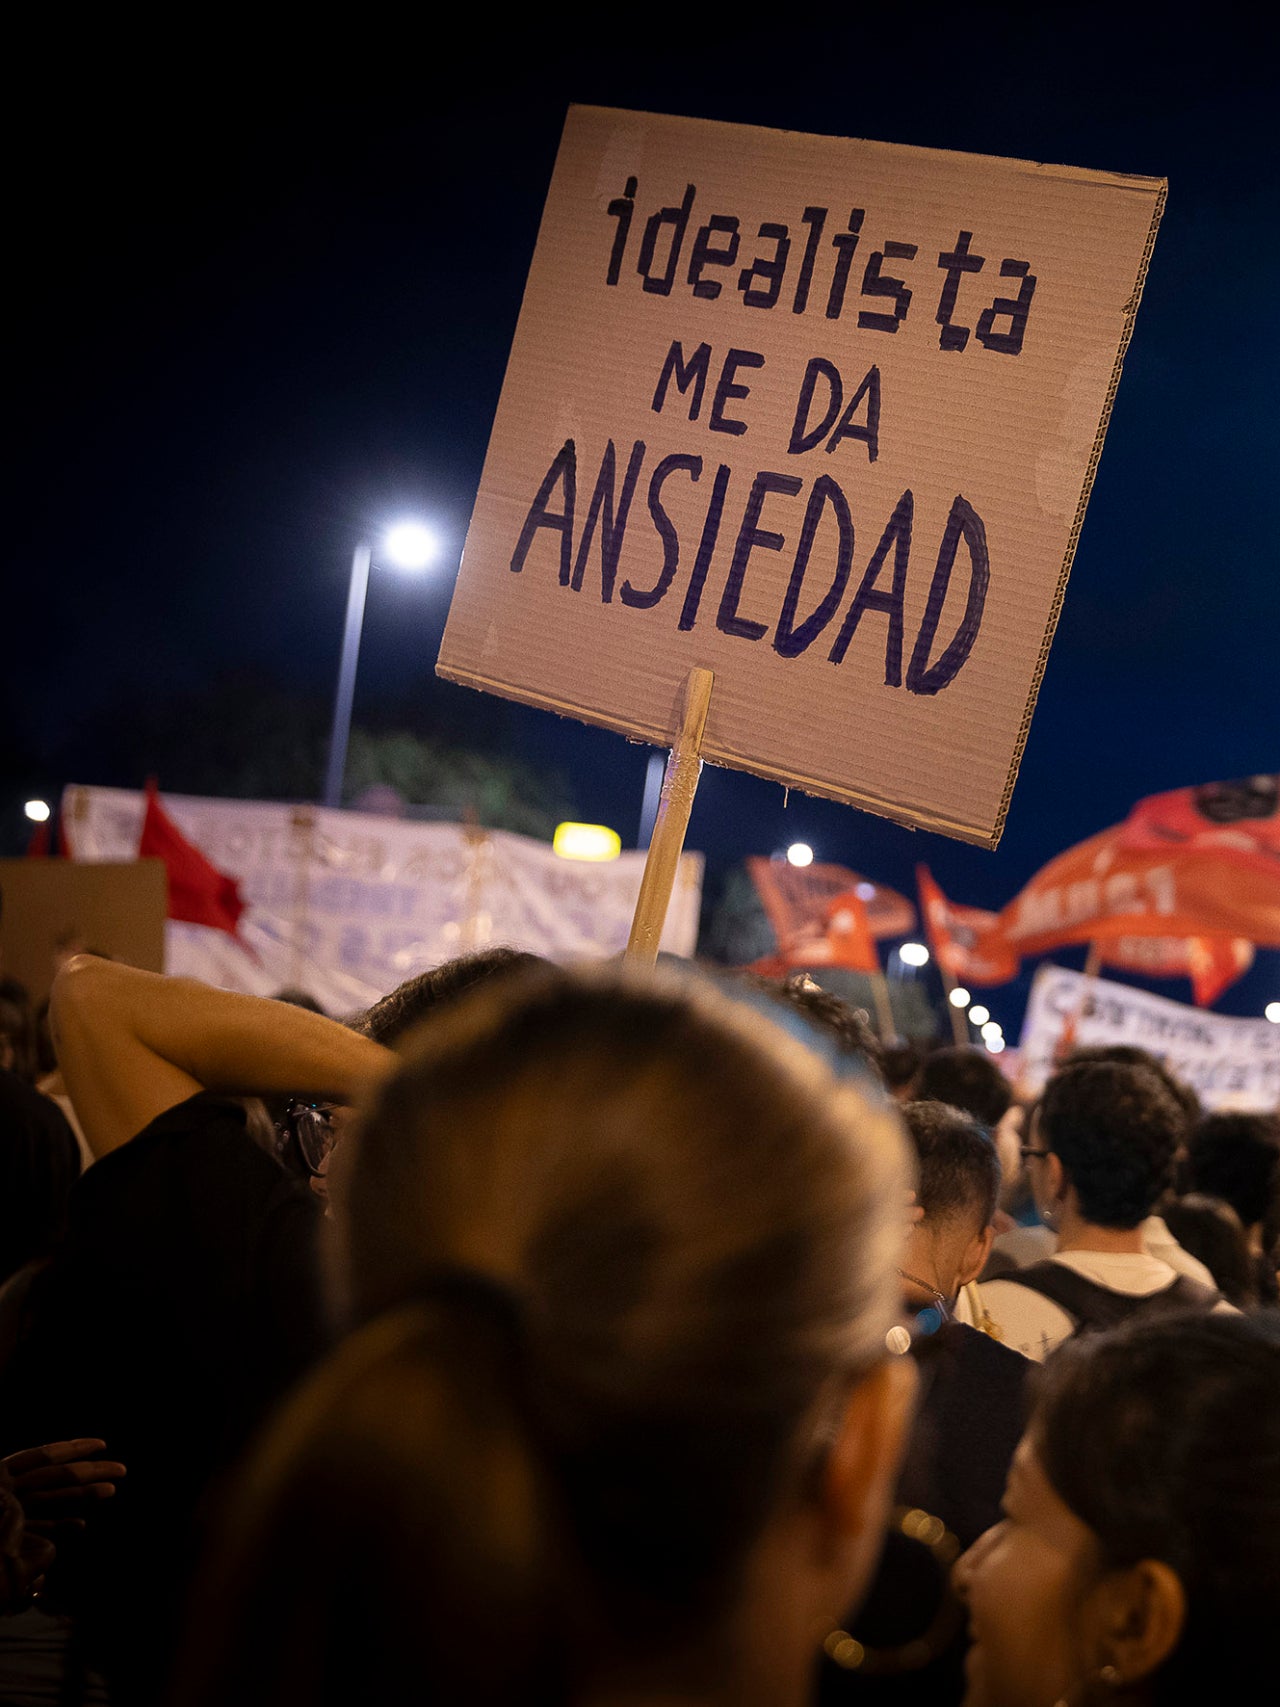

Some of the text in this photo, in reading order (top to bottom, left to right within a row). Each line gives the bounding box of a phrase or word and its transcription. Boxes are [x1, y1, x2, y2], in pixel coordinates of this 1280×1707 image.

[606, 175, 1038, 356] idealista
[651, 340, 881, 463] ME DA
[509, 438, 991, 696] ANSIEDAD
